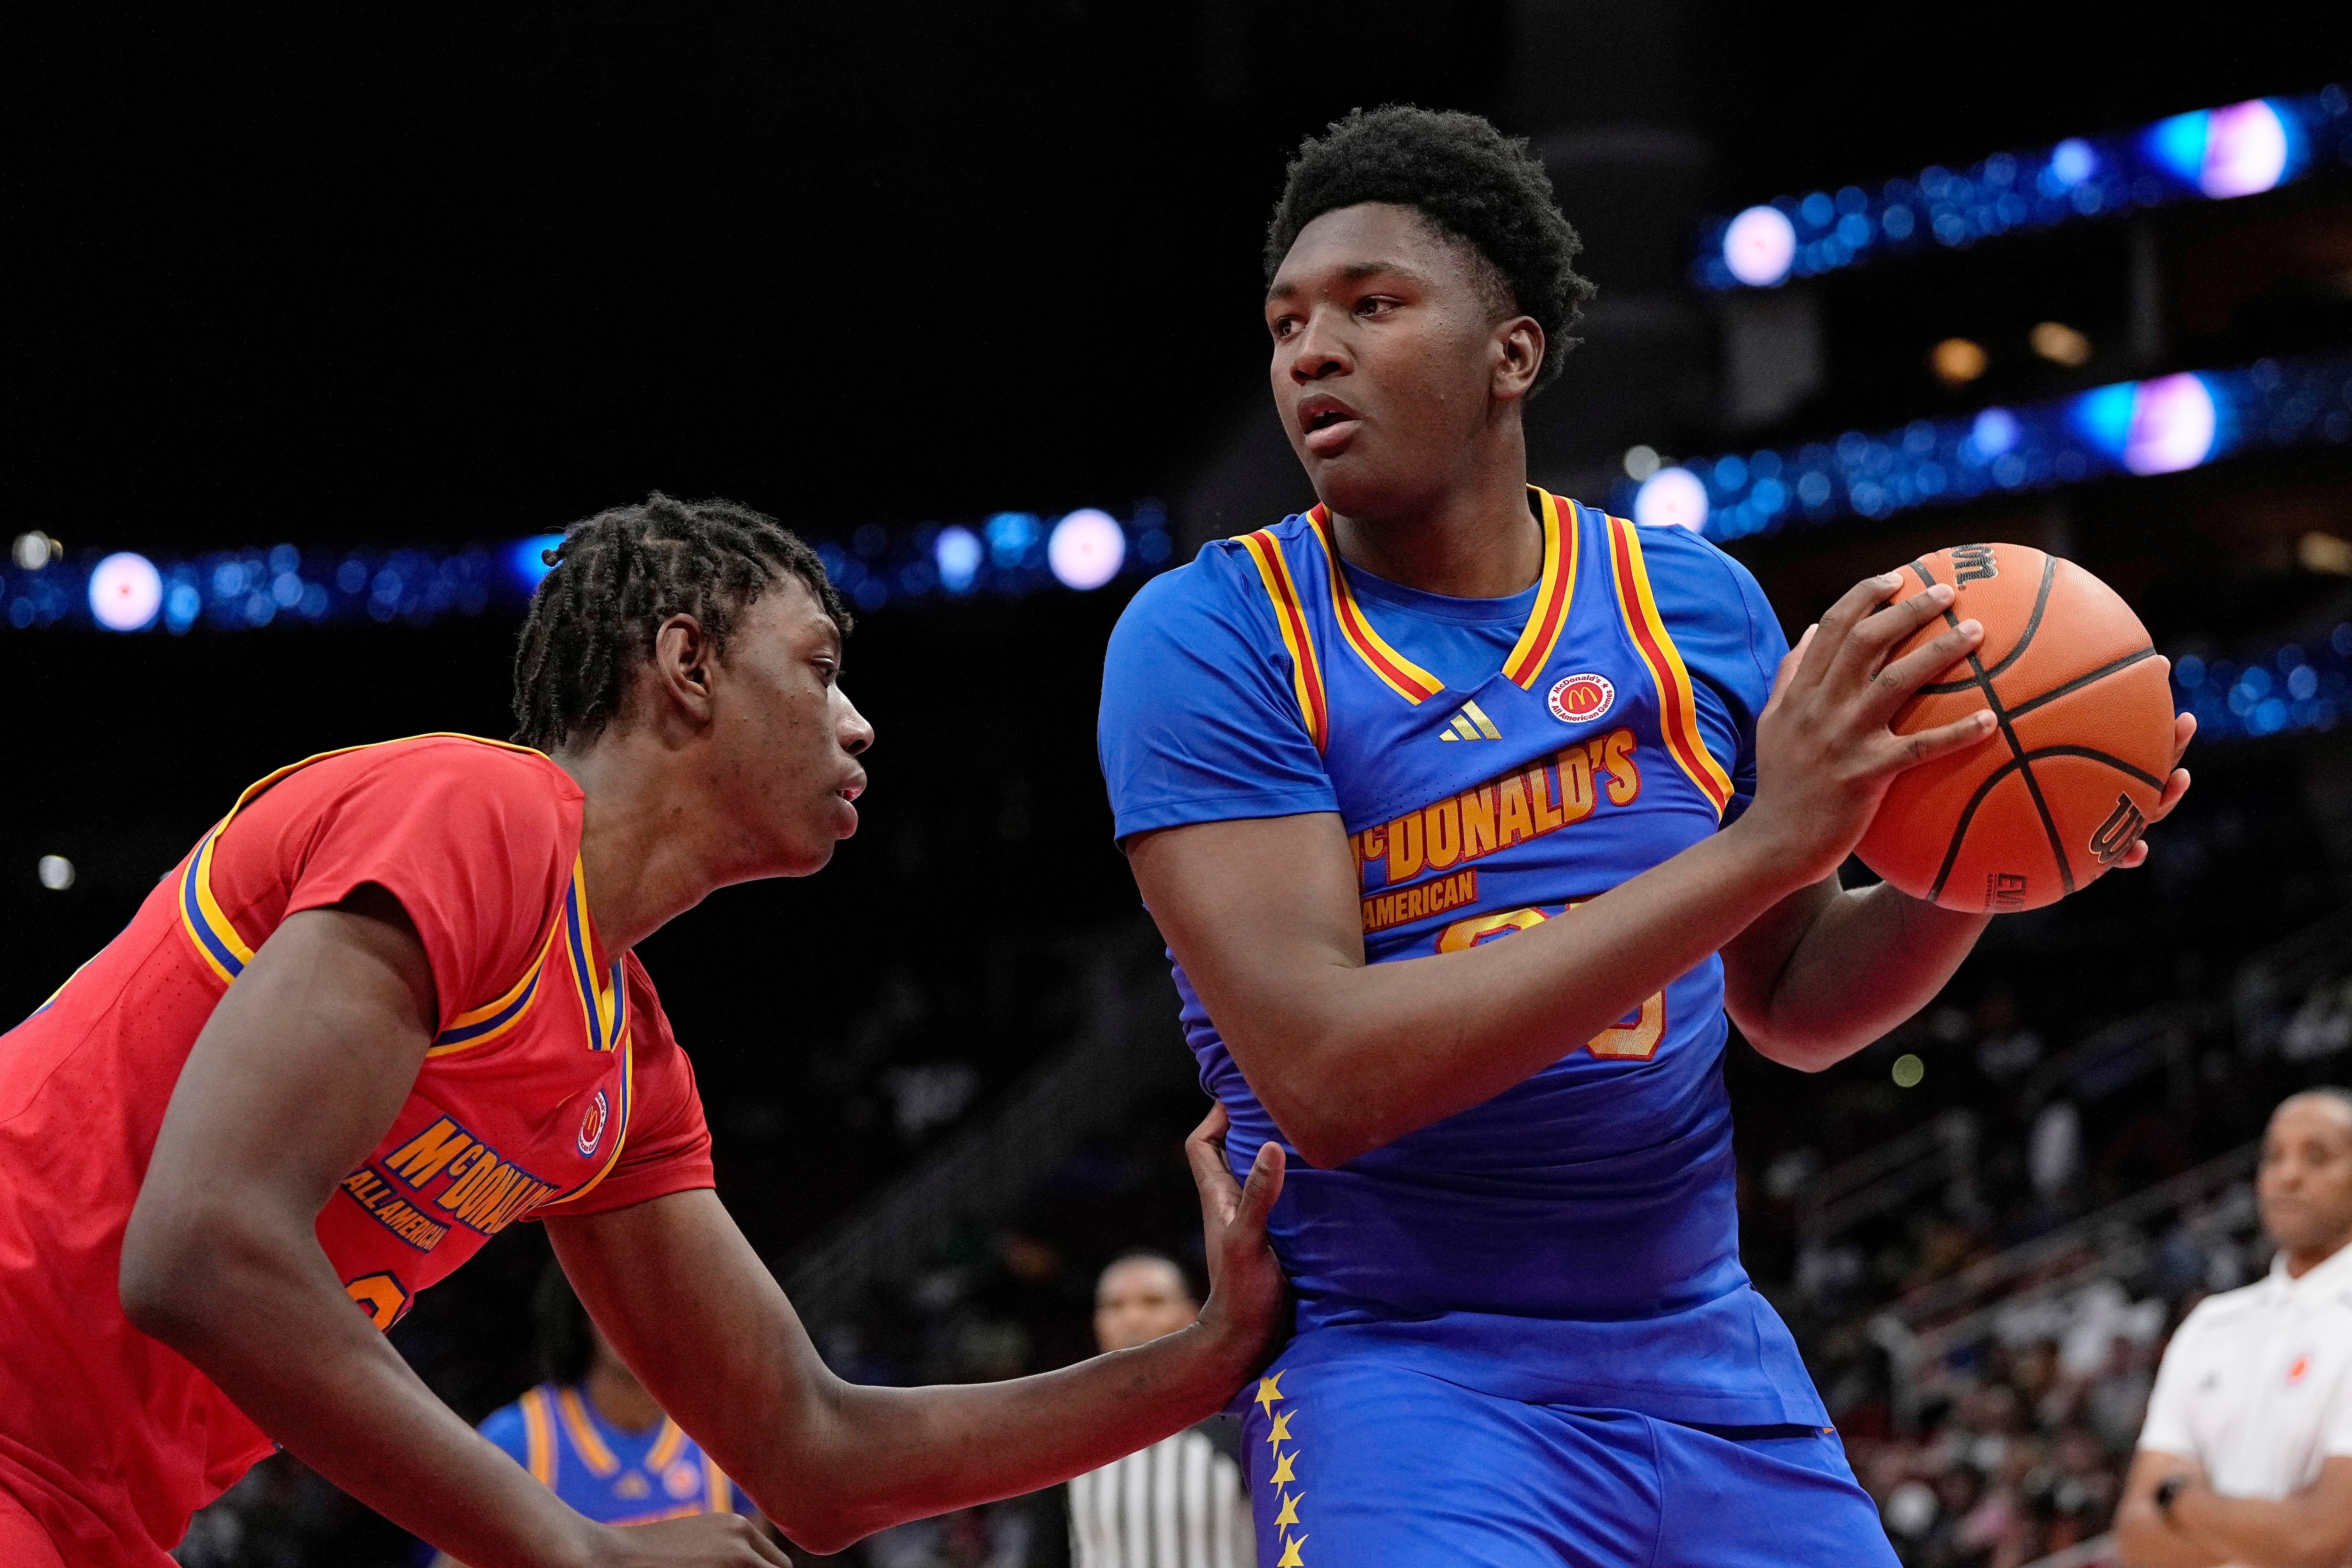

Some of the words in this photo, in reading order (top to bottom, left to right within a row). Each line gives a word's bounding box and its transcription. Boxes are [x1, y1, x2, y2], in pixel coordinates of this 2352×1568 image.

[1551, 705, 1563, 715] All
[1558, 712, 1599, 721] American
[1597, 690, 1613, 713] Games
[1553, 675, 1601, 694] McDonald's
[1348, 727, 1641, 884] cDONALD'S
[1363, 870, 1474, 931] AMERICAN
[342, 1169, 392, 1210] ALL
[373, 1199, 449, 1252] AMERICAN
